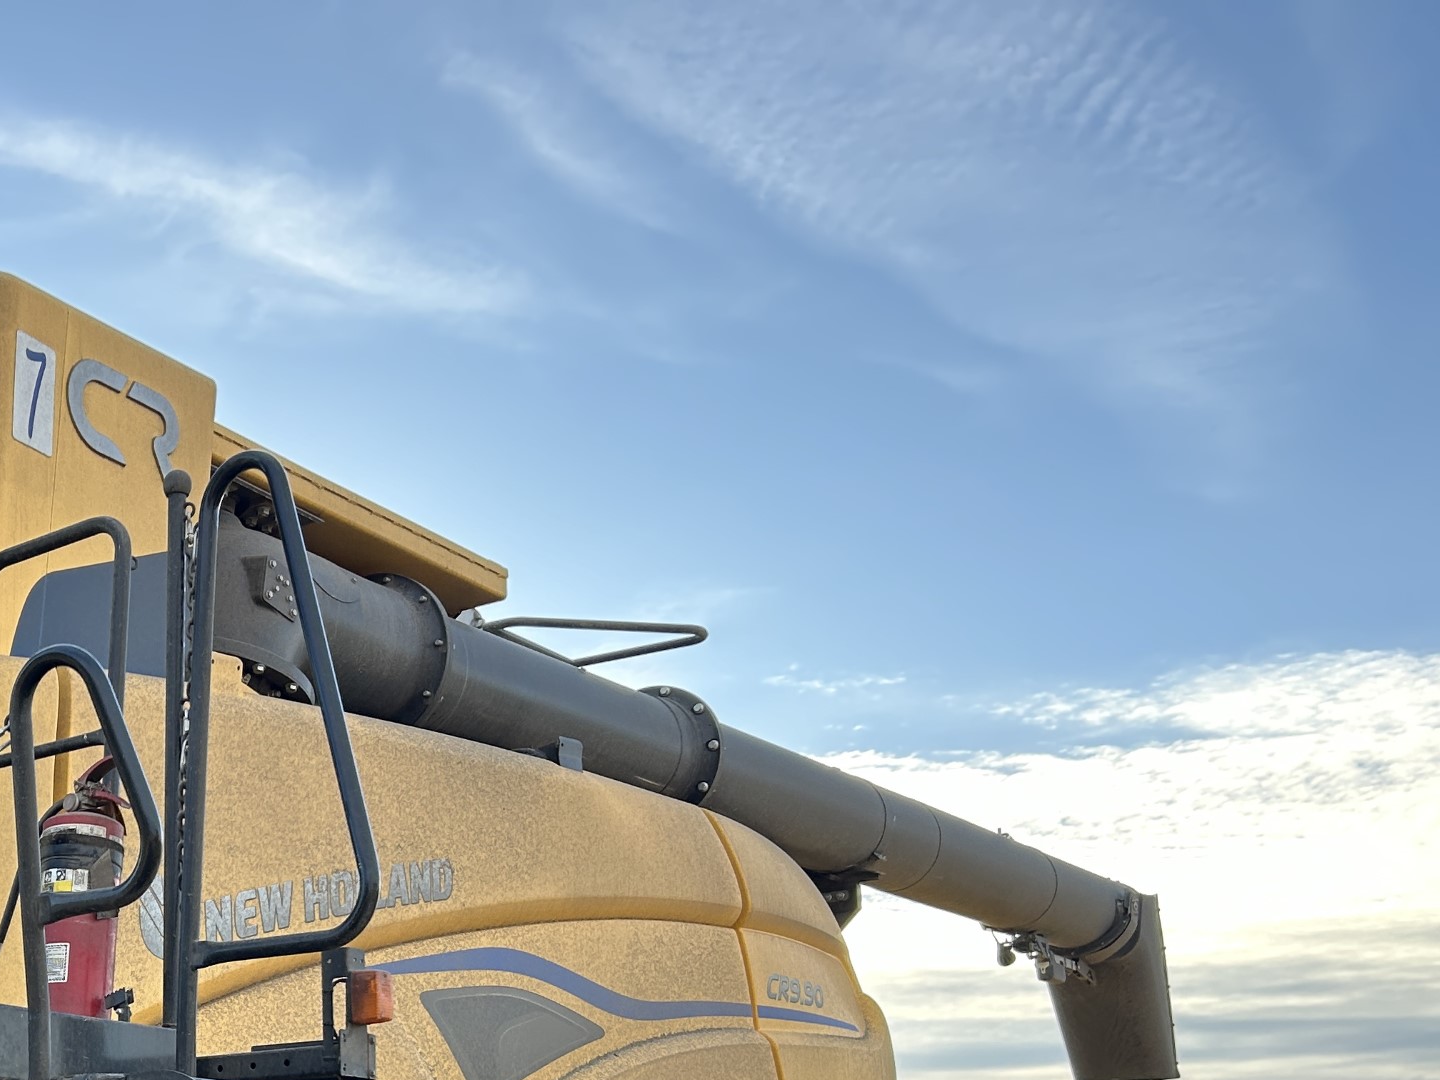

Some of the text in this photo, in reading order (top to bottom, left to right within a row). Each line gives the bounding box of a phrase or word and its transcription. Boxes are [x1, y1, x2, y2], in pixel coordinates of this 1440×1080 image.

[25, 347, 47, 440] 7
[204, 858, 454, 942] NEW HOAND
